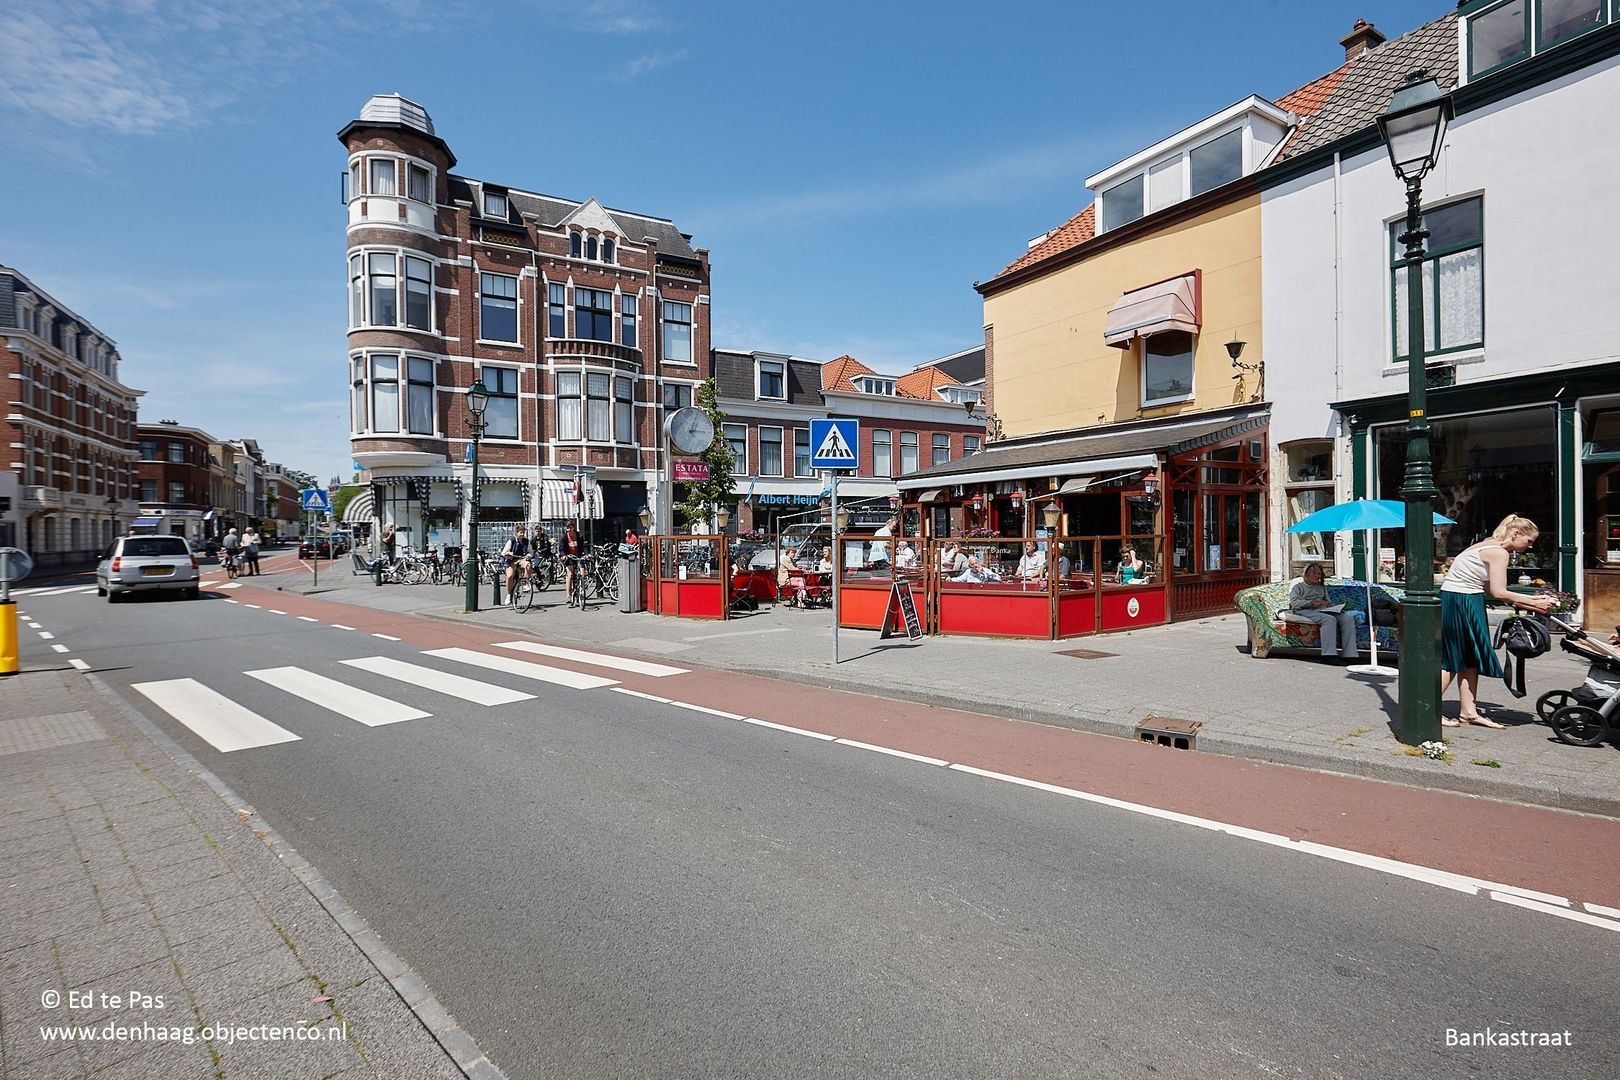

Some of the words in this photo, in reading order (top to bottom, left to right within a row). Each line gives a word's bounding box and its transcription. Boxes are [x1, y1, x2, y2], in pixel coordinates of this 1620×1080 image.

[675, 464, 708, 472] ESTATA
[758, 495, 791, 504] Albert
[793, 495, 818, 506] Heijn
